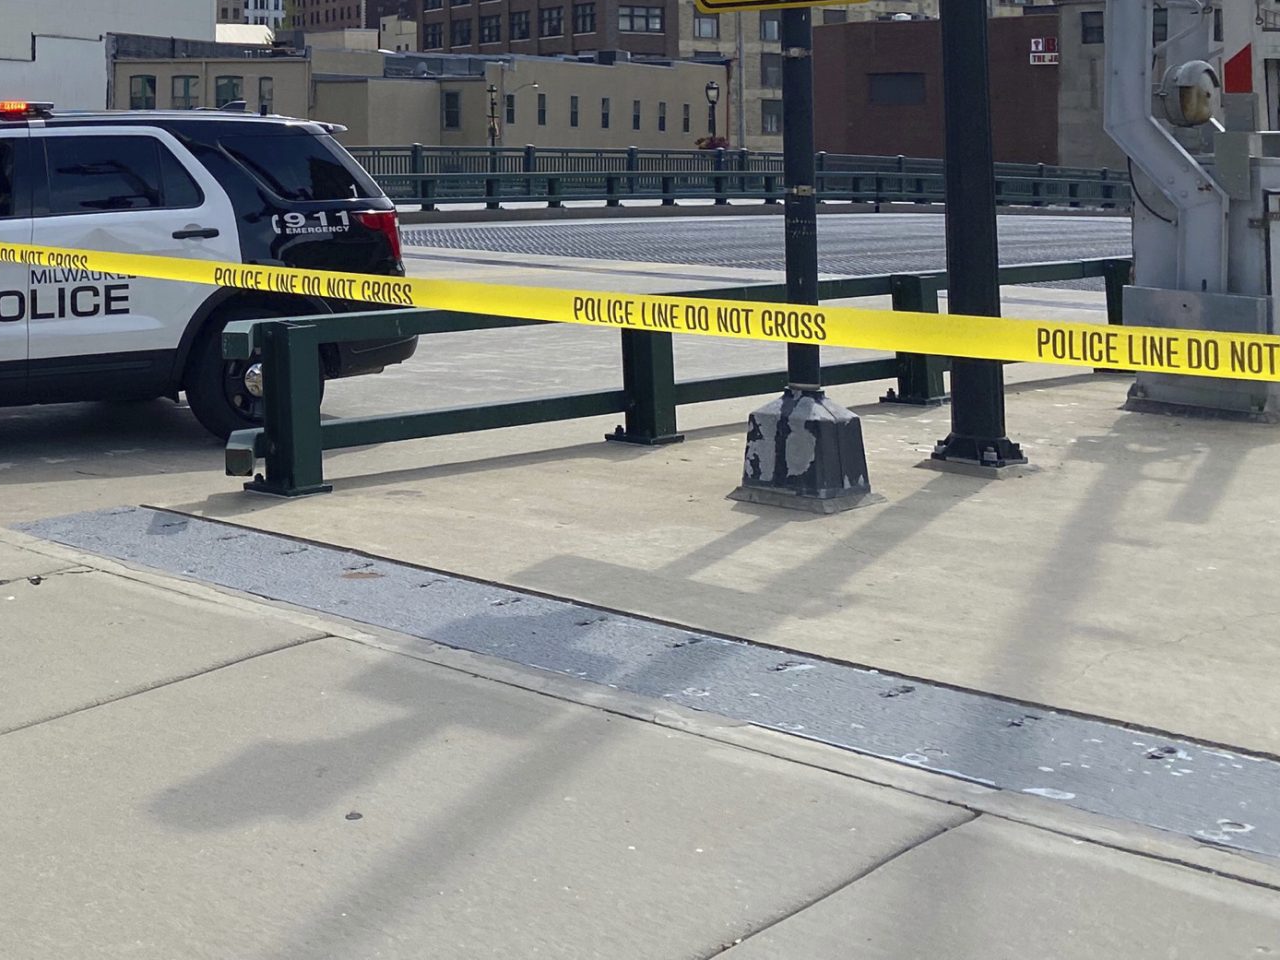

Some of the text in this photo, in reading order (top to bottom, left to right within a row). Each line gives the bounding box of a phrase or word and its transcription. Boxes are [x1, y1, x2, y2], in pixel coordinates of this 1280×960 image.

[349, 184, 358, 197] 1
[283, 210, 350, 227] 911
[286, 225, 350, 235] EMERGENCY
[0, 248, 16, 262] DO
[20, 250, 44, 265] NOT
[47, 252, 89, 271] CROSS
[31, 268, 137, 284] MILWAUK
[214, 267, 414, 305] POLICE LINE DO NOT CROSS
[573, 296, 827, 341] POLICE LINE DO NOT CROSS
[1037, 327, 1280, 375] POLICE LINE DO NOT
